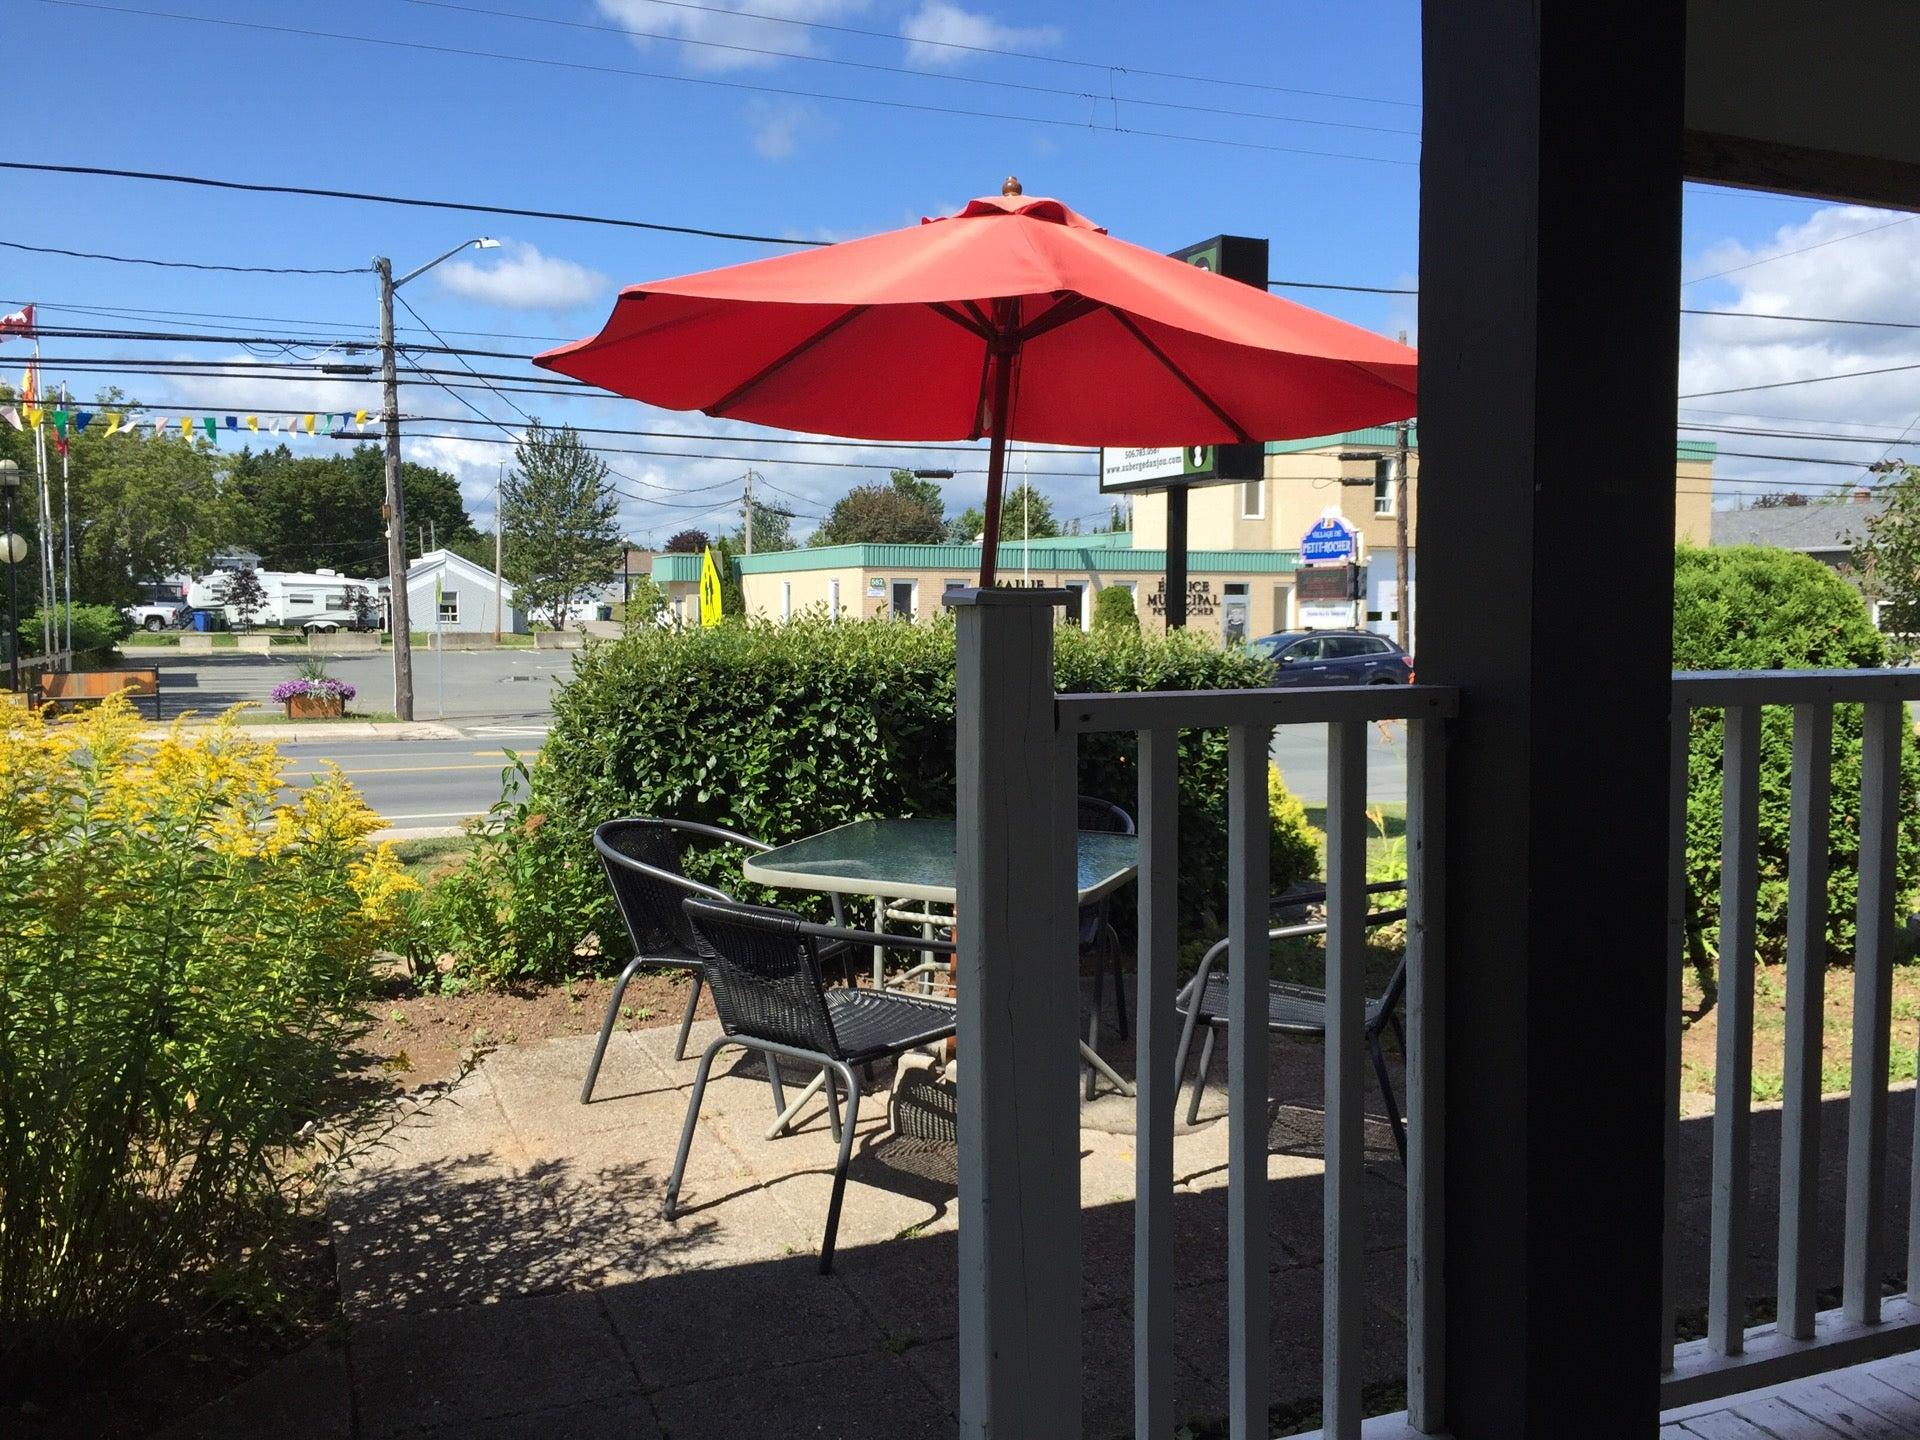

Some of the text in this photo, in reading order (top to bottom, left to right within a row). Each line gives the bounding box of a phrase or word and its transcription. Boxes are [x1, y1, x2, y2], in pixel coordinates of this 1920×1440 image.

[1303, 540, 1350, 554] PETIT-ROCHER
[1157, 576, 1210, 593] ÉICE
[1147, 594, 1221, 606] MUCIPAL
